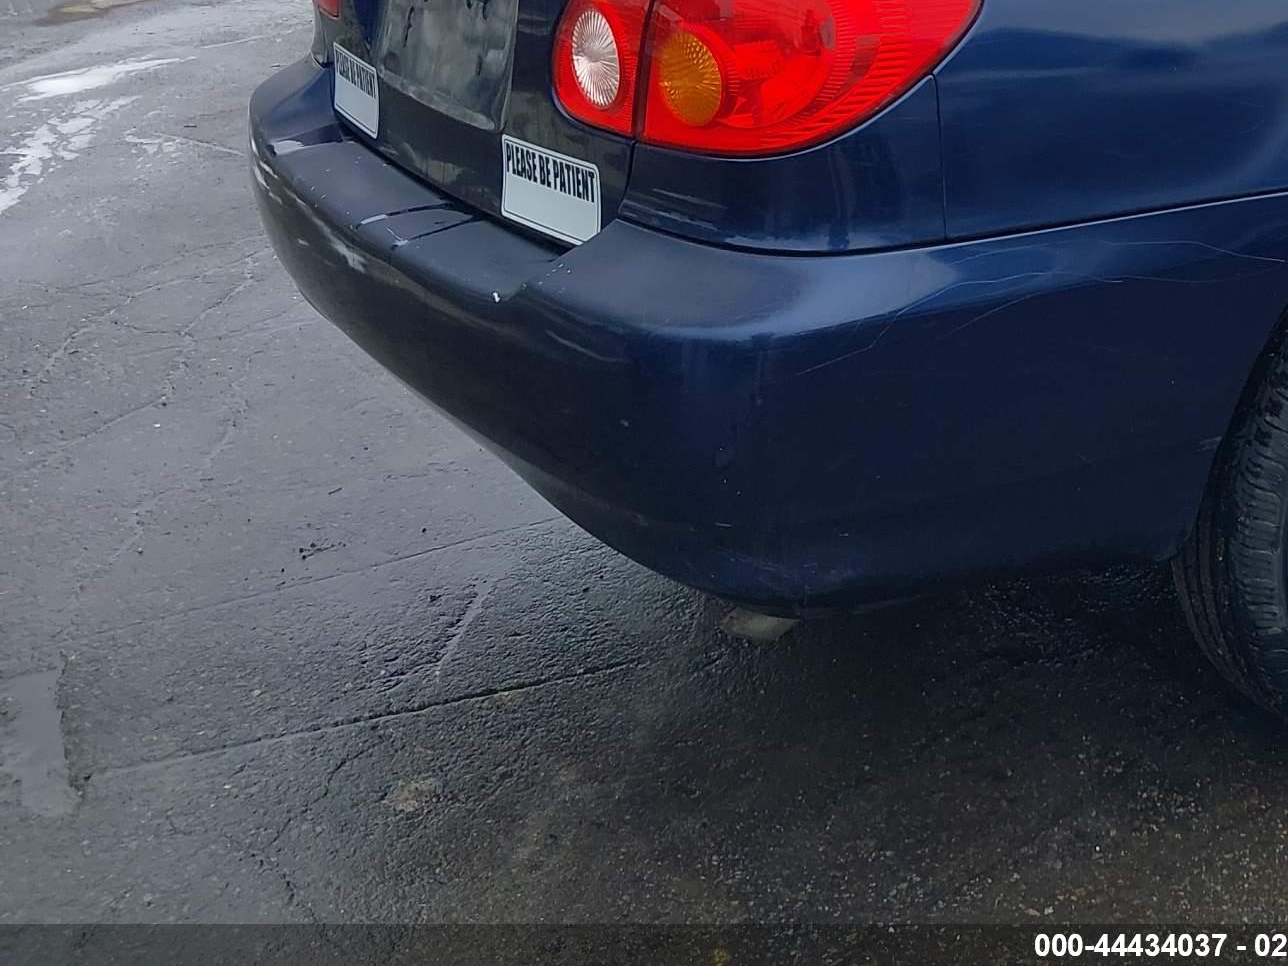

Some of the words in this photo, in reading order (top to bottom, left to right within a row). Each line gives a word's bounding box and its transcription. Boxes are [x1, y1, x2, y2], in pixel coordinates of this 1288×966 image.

[505, 142, 538, 184] PLEASE
[538, 154, 552, 189] BE
[552, 158, 596, 204] PATIENT
